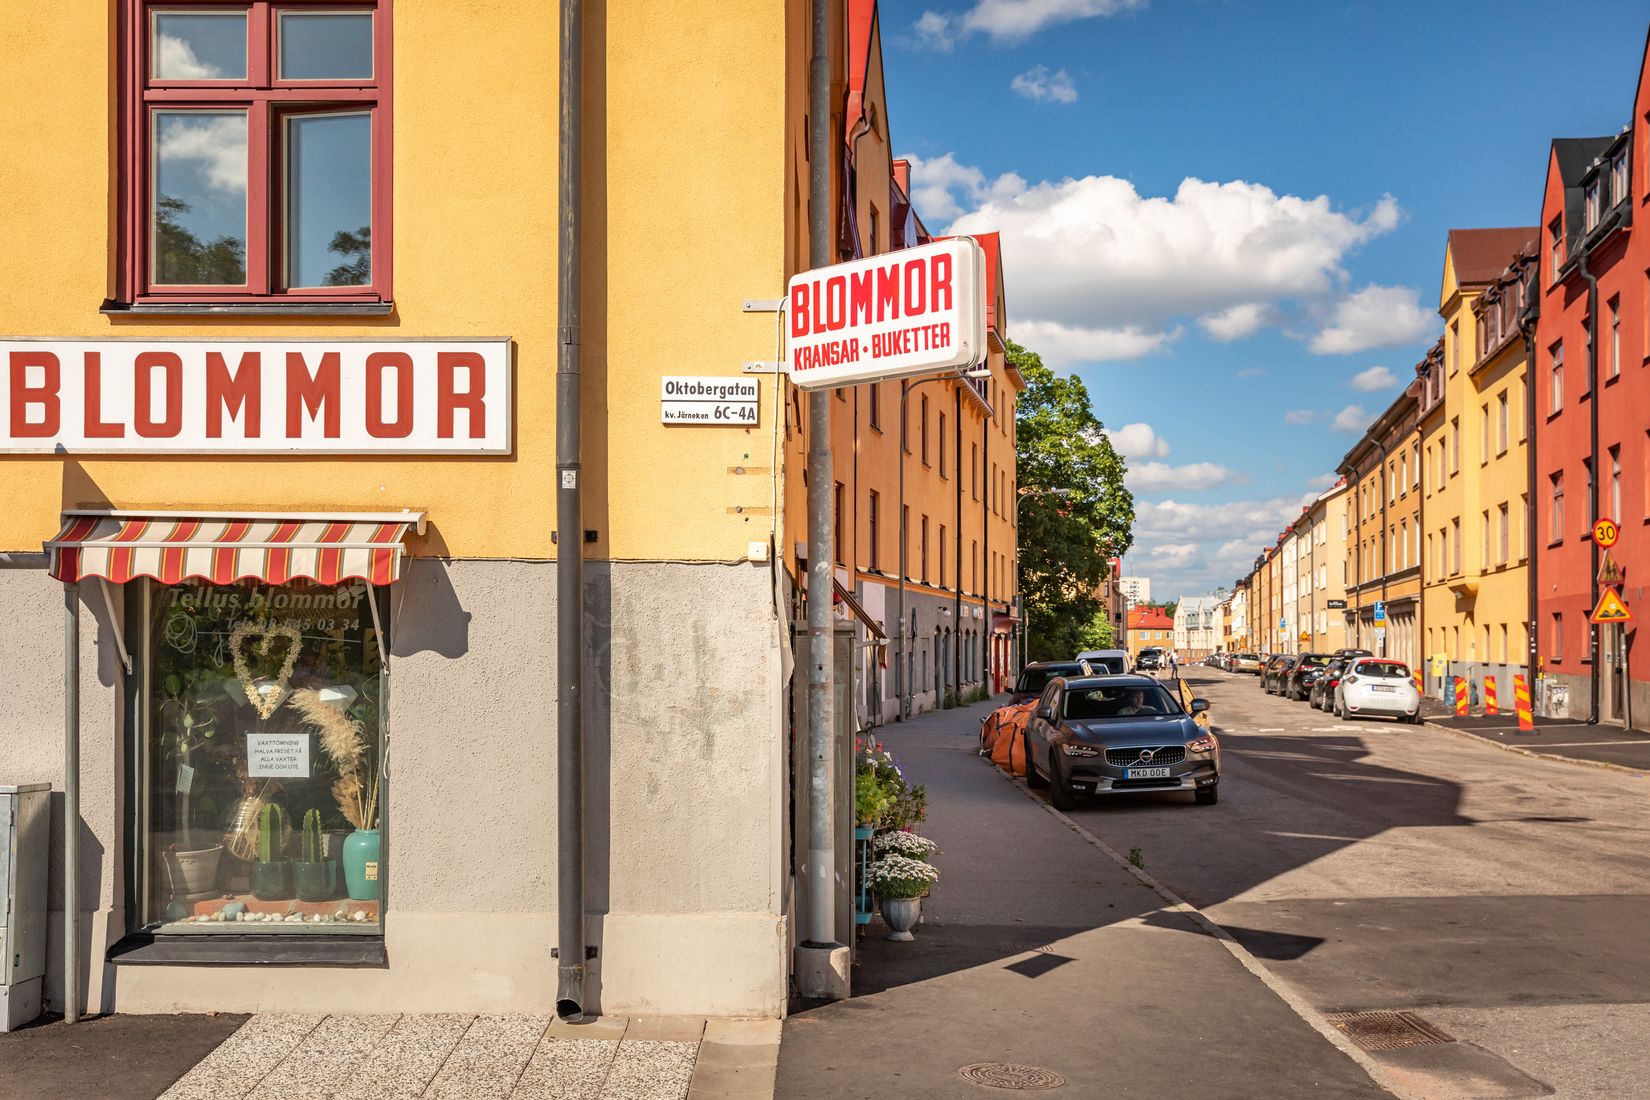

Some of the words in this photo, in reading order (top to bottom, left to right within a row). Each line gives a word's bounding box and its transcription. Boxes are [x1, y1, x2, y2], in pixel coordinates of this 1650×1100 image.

[791, 252, 953, 338] BLOMMOR
[793, 337, 860, 371] KRANSAR
[871, 321, 950, 359] BUKETTER
[9, 351, 486, 438] BLOMMOR
[665, 380, 755, 399] Oktobergatan
[664, 410, 676, 419] kv.
[677, 410, 709, 420] Järneken
[714, 405, 756, 421] 6C-4A
[1597, 525, 1615, 541] 30
[169, 587, 242, 608] Tellus
[250, 585, 365, 610] blommor
[317, 618, 335, 631] 03
[343, 618, 360, 631] 34
[1130, 769, 1148, 777] MKD
